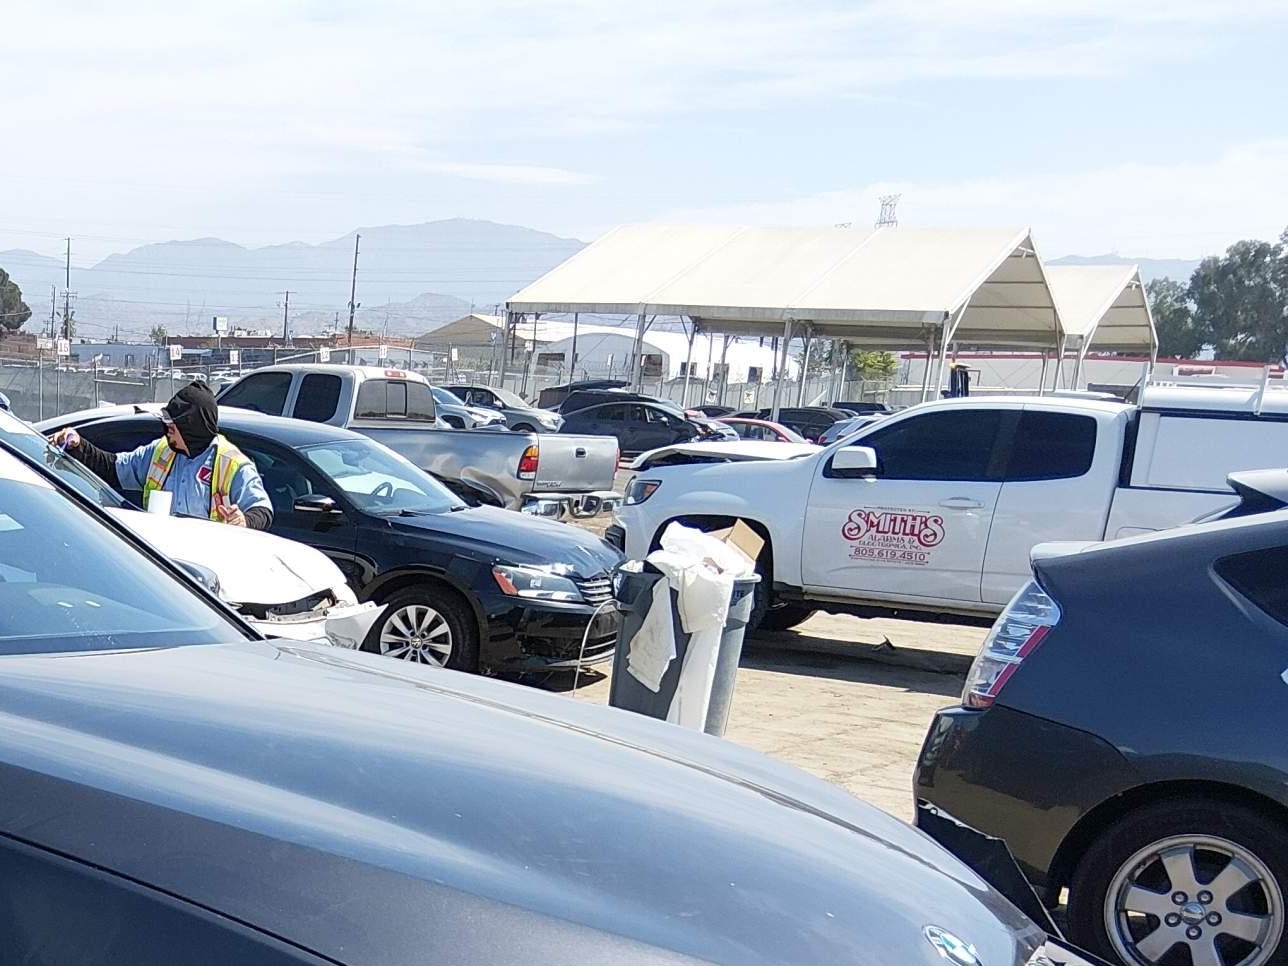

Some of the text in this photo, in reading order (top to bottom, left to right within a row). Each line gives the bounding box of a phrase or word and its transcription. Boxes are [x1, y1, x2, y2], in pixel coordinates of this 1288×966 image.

[842, 509, 945, 548] SMITH'S
[868, 534, 905, 545] ALARMS
[854, 547, 926, 561] 805.619.4510
